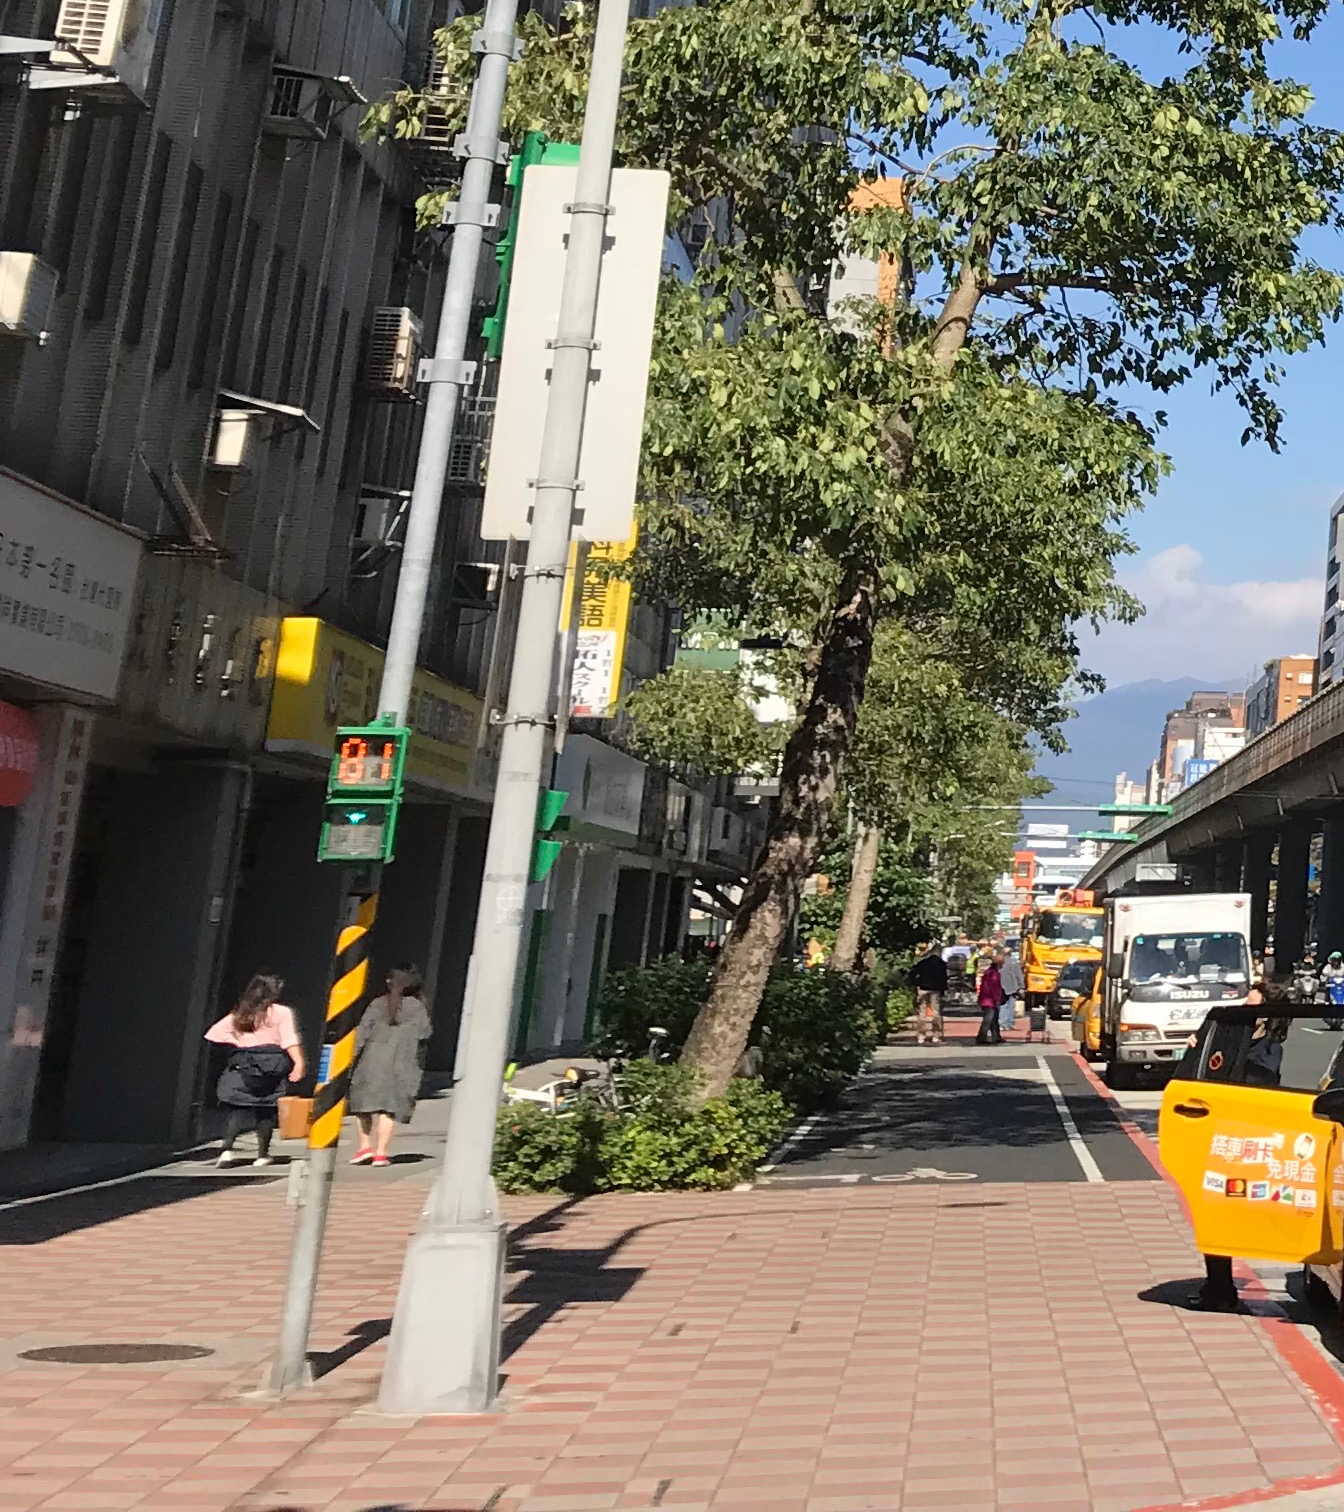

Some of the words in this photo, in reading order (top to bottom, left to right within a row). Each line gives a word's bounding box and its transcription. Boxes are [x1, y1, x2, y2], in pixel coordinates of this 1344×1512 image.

[338, 738, 394, 785] 81
[1170, 990, 1210, 1000] ISUZU
[1206, 1175, 1225, 1189] VISA
